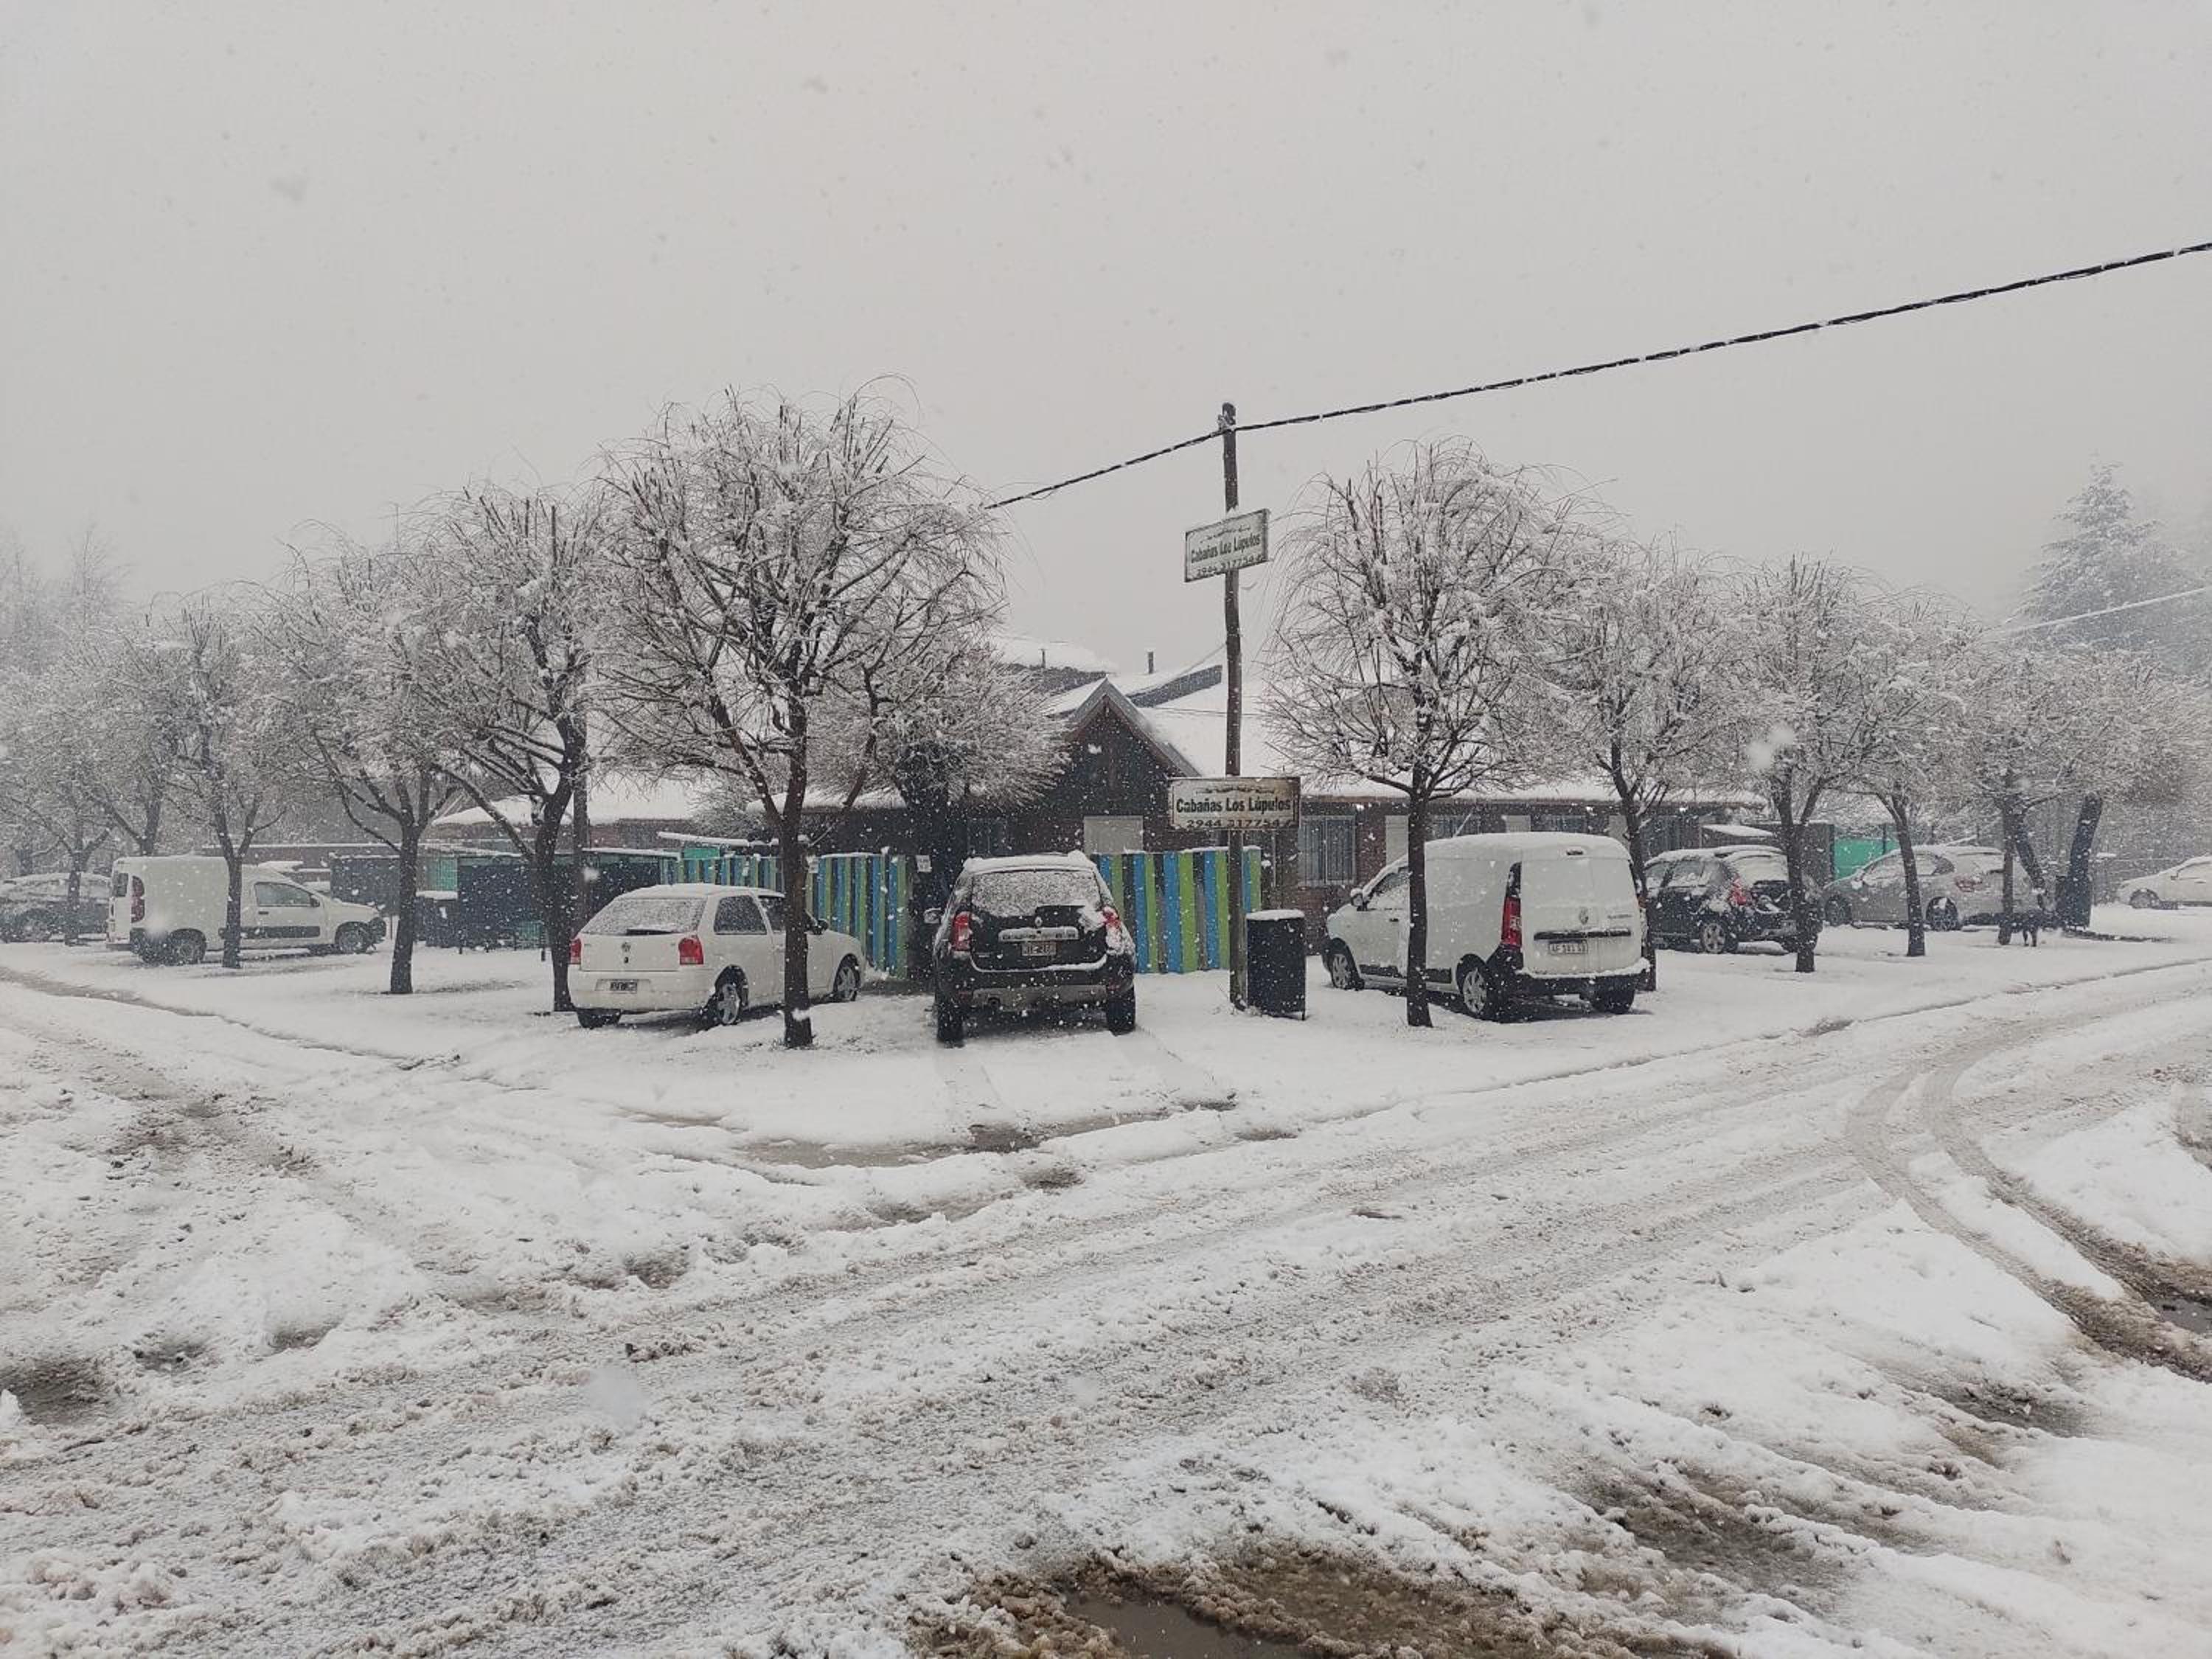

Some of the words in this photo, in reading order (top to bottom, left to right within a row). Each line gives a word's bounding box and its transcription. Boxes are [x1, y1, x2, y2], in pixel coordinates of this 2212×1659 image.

[1176, 798, 1223, 813] Cabañas
[1225, 797, 1245, 813] Los
[1248, 796, 1292, 815] Lúpulos
[1186, 819, 1222, 829] 2944
